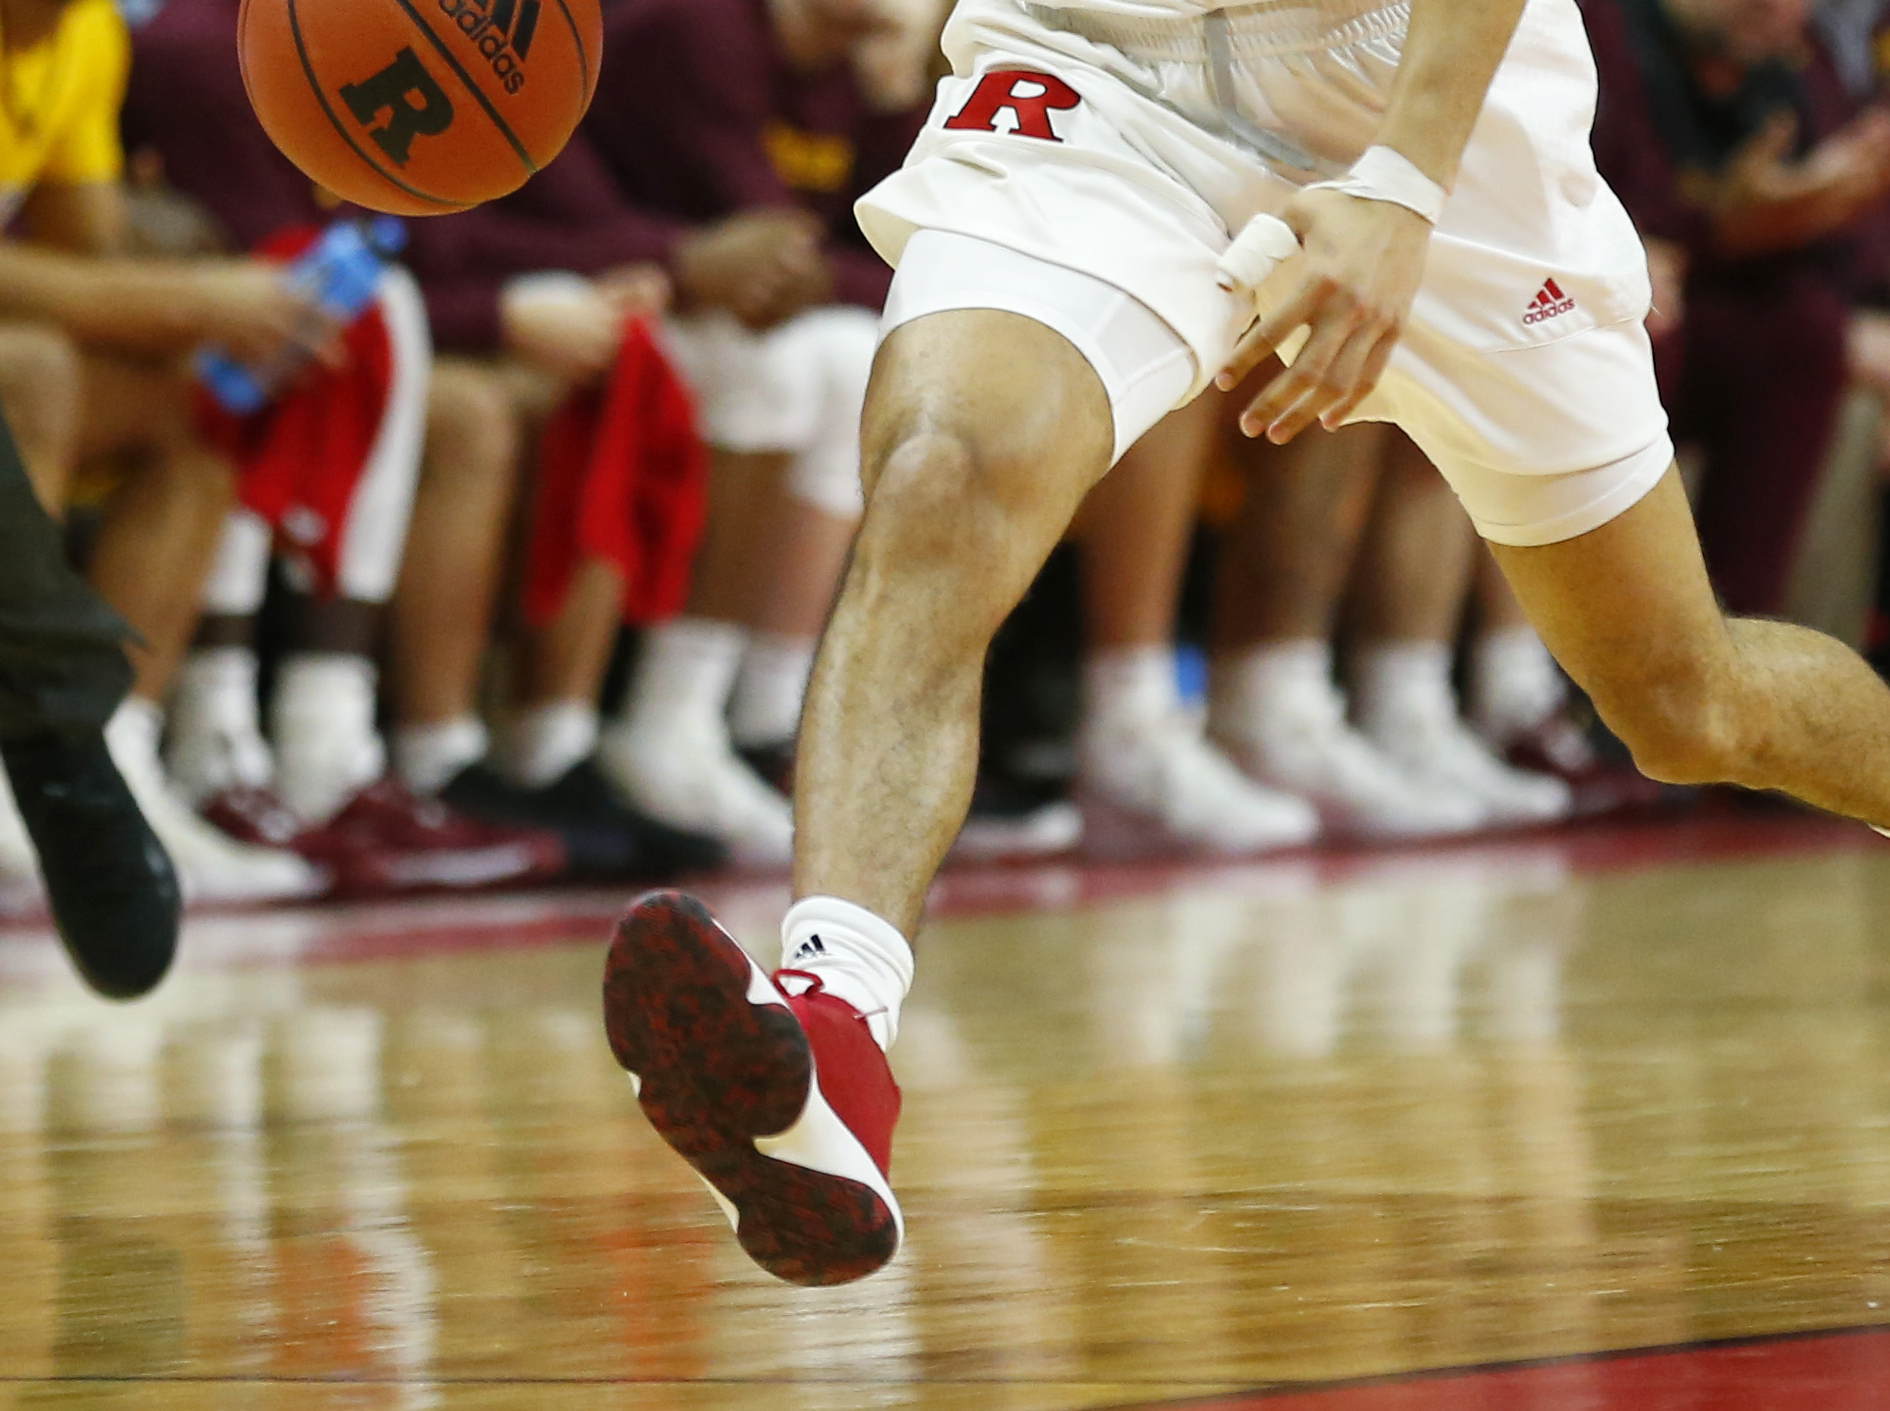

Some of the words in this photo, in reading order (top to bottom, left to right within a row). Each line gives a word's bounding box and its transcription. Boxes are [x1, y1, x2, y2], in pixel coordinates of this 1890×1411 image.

[339, 45, 455, 170] R
[943, 70, 1082, 143] R
[1523, 297, 1576, 325] adidas
